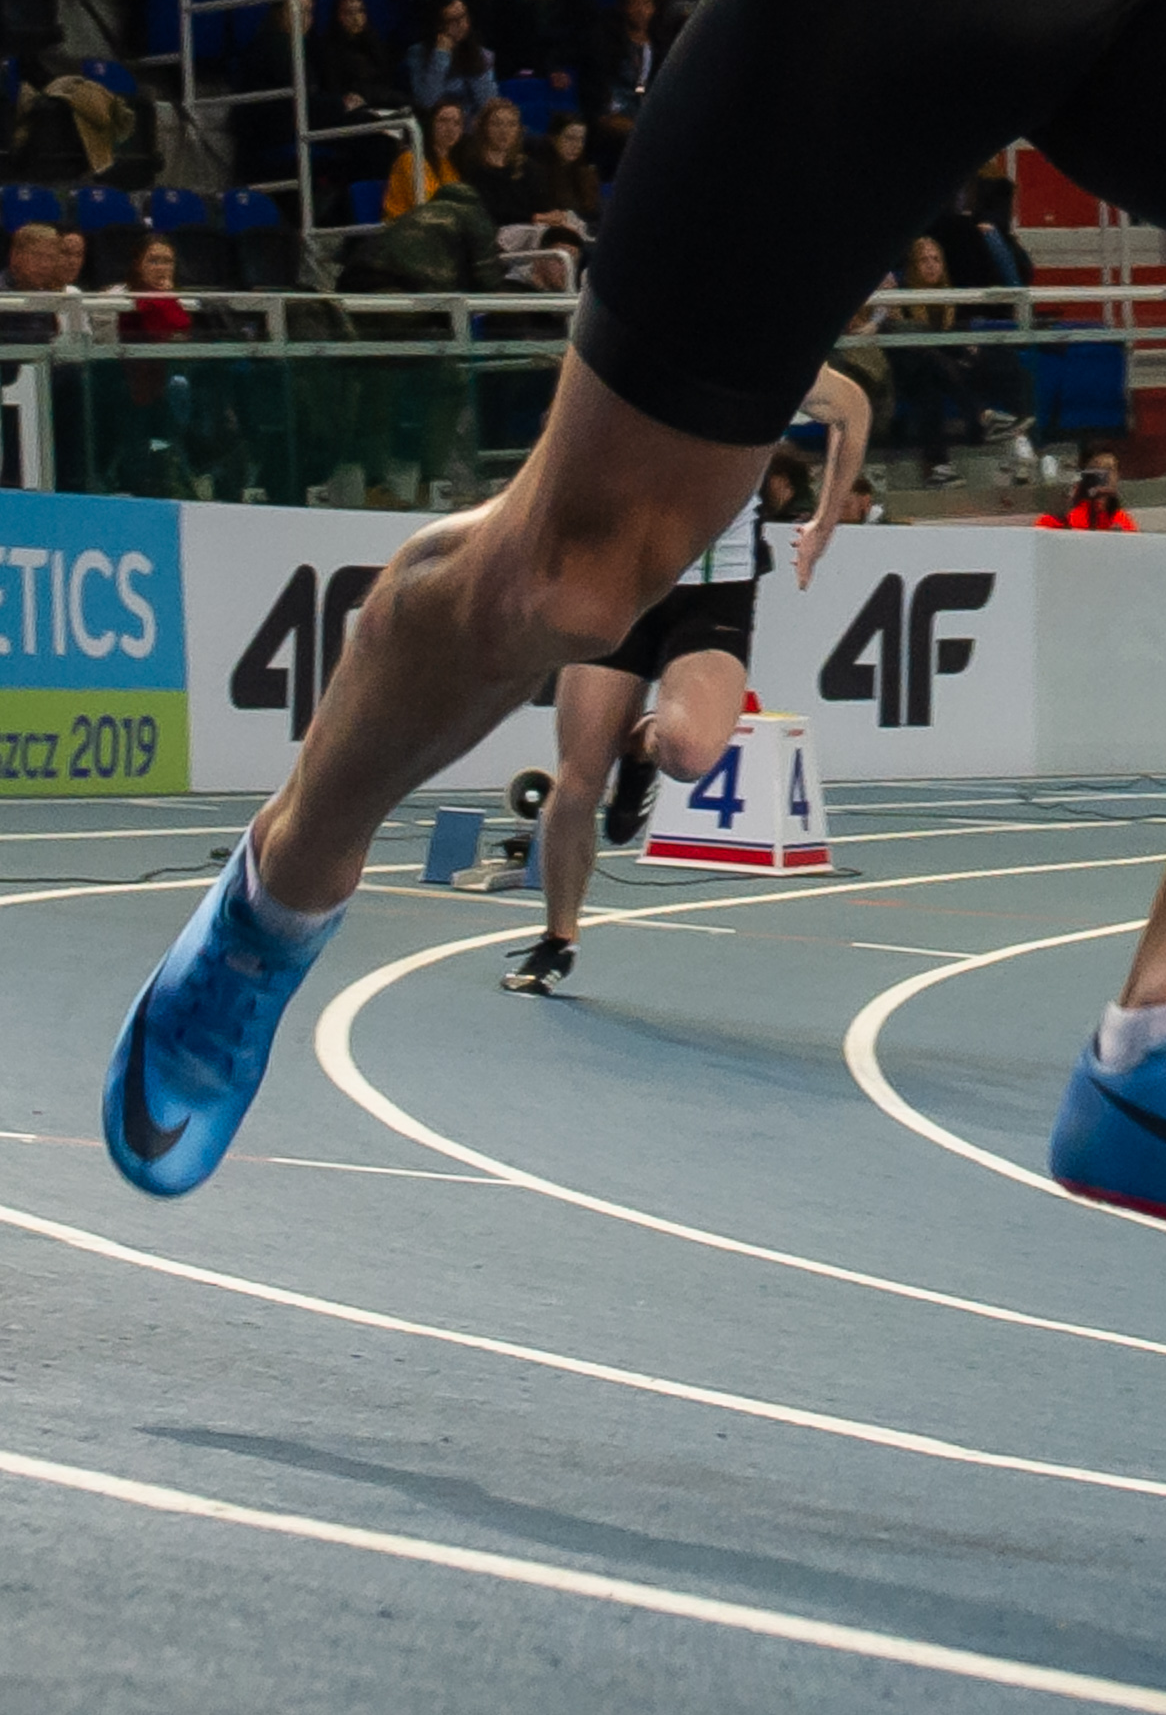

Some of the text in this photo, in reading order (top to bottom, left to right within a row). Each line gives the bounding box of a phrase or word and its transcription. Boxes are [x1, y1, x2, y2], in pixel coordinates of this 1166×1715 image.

[817, 571, 996, 728] 4F
[68, 714, 158, 779] 2019
[688, 744, 746, 830] 4
[789, 747, 810, 833] 4
